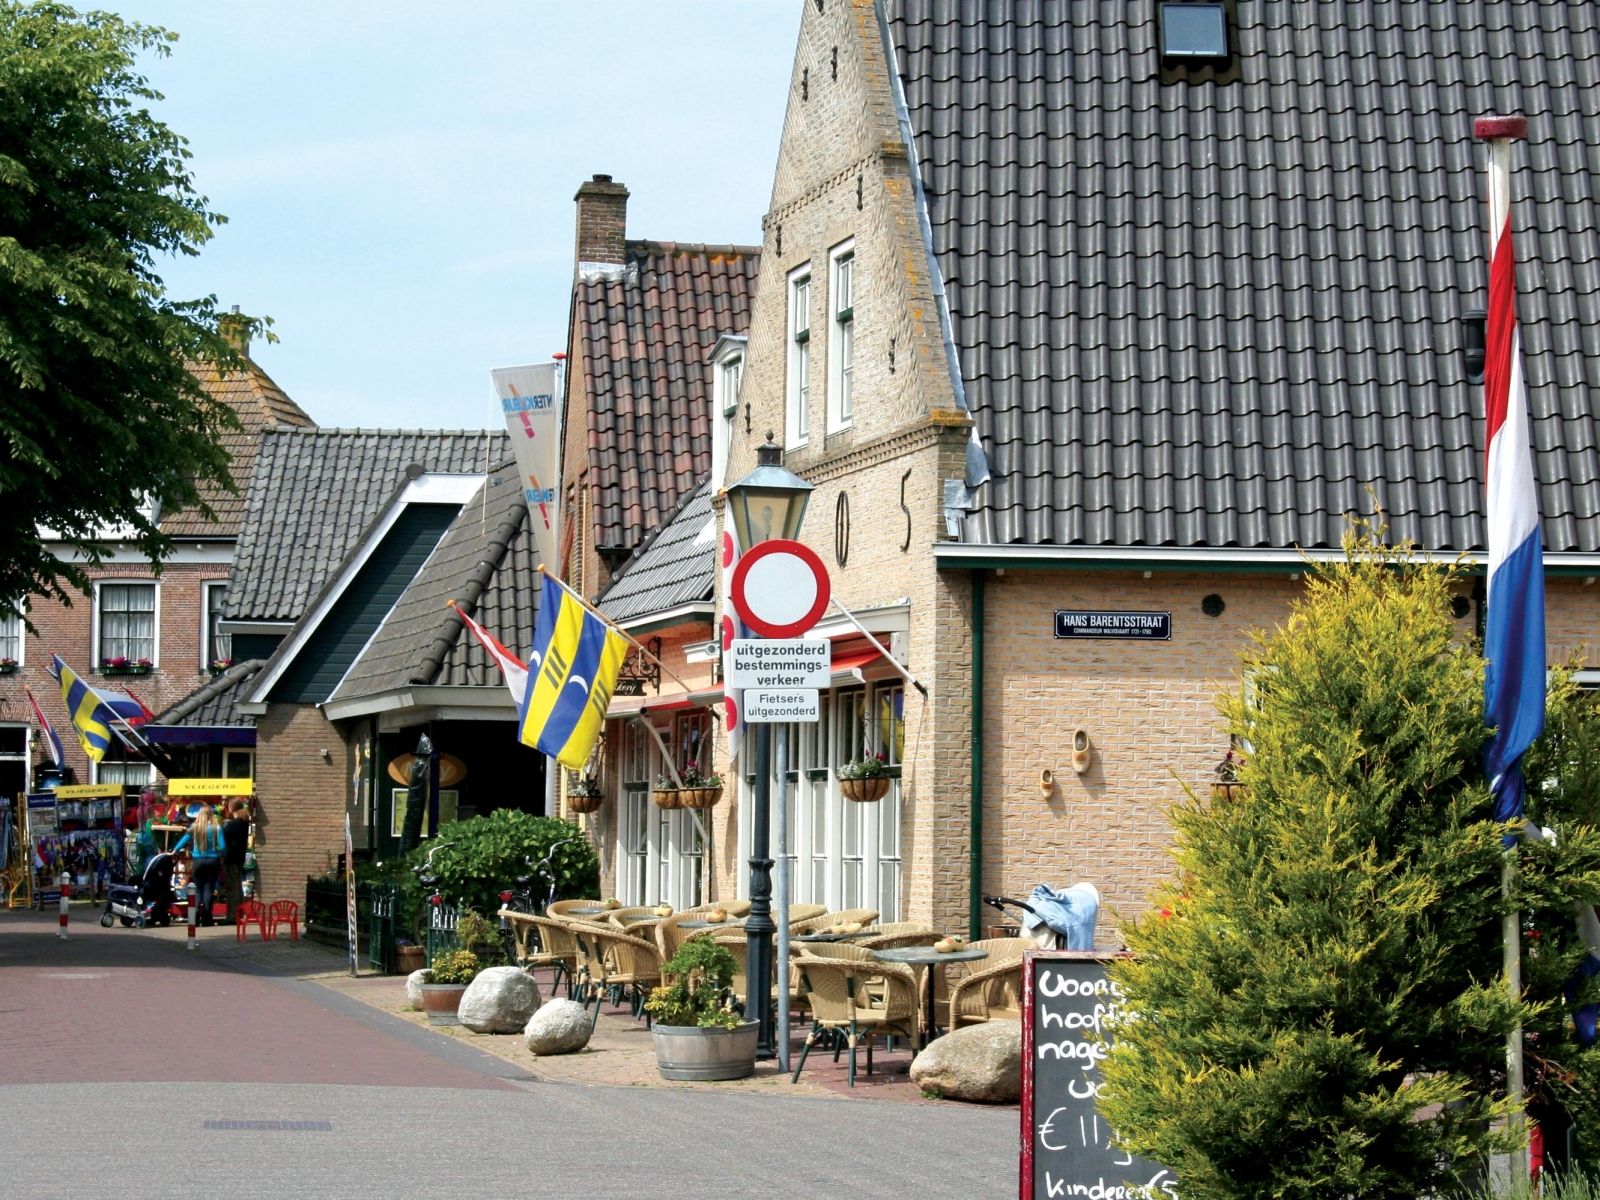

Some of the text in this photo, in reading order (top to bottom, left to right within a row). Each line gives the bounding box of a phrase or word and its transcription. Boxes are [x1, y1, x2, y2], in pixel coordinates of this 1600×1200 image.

[1063, 614, 1164, 628] HANS BARENTSSTRAAT
[736, 643, 825, 659] uitgezonderd
[735, 659, 829, 673] bestemmings-
[756, 673, 806, 686] verkeer
[759, 693, 805, 704] Fietsers
[748, 706, 816, 718] uitgezonderd
